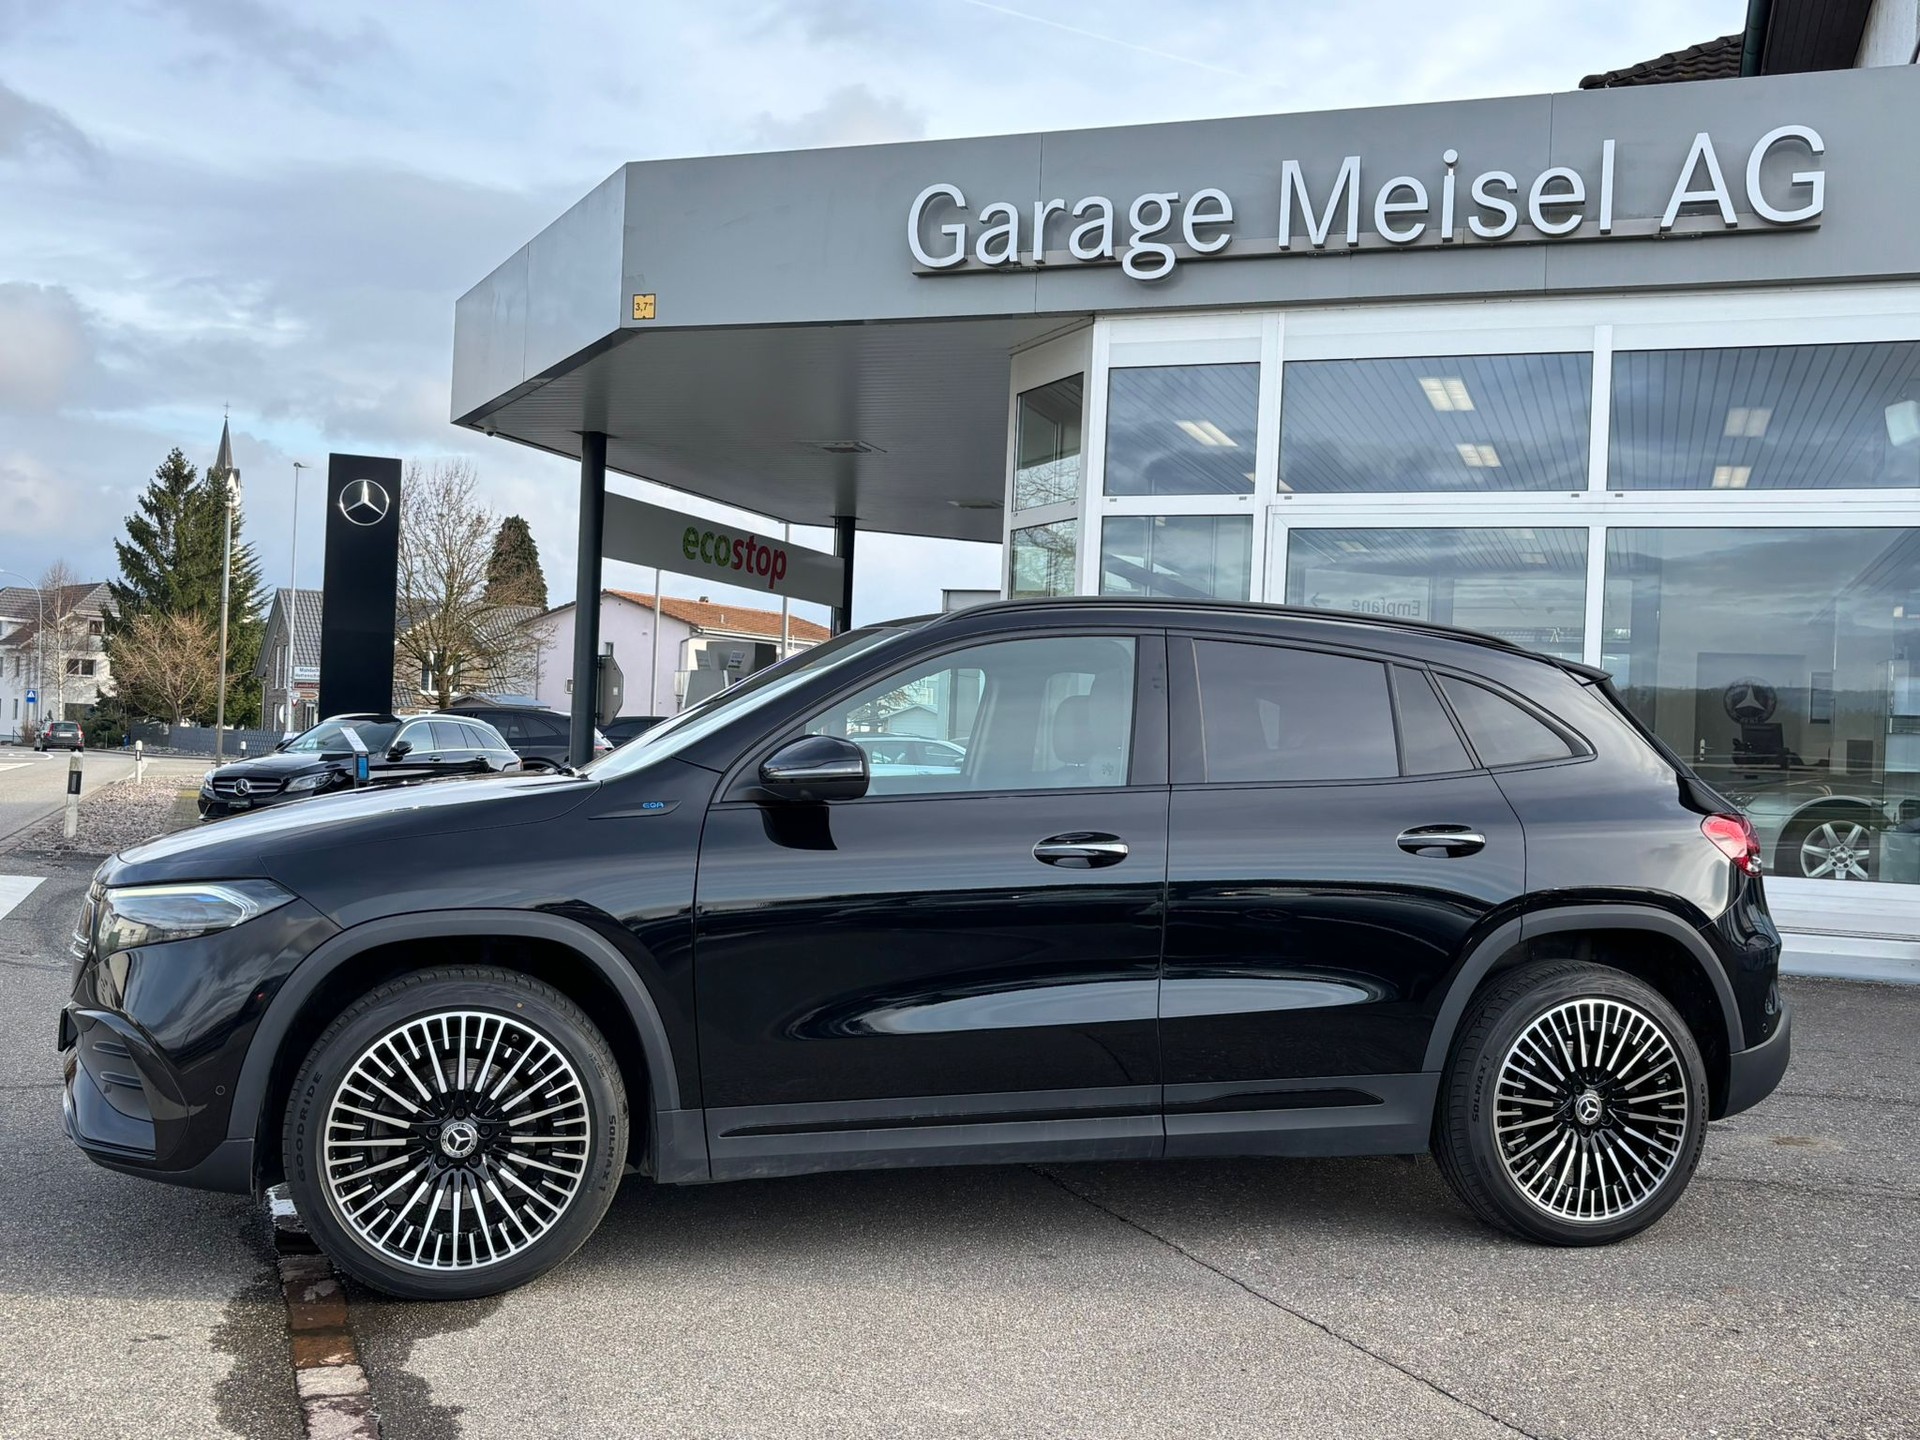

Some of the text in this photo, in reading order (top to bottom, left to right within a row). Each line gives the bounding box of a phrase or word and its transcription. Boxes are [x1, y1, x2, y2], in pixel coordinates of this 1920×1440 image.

[906, 124, 1827, 281] Garage Meisel AG
[682, 526, 787, 590] ecostop
[296, 1071, 323, 1182] GOODRIDE
[1472, 1066, 1487, 1123] SOLMAX
[602, 1114, 617, 1180] SOLMAX
